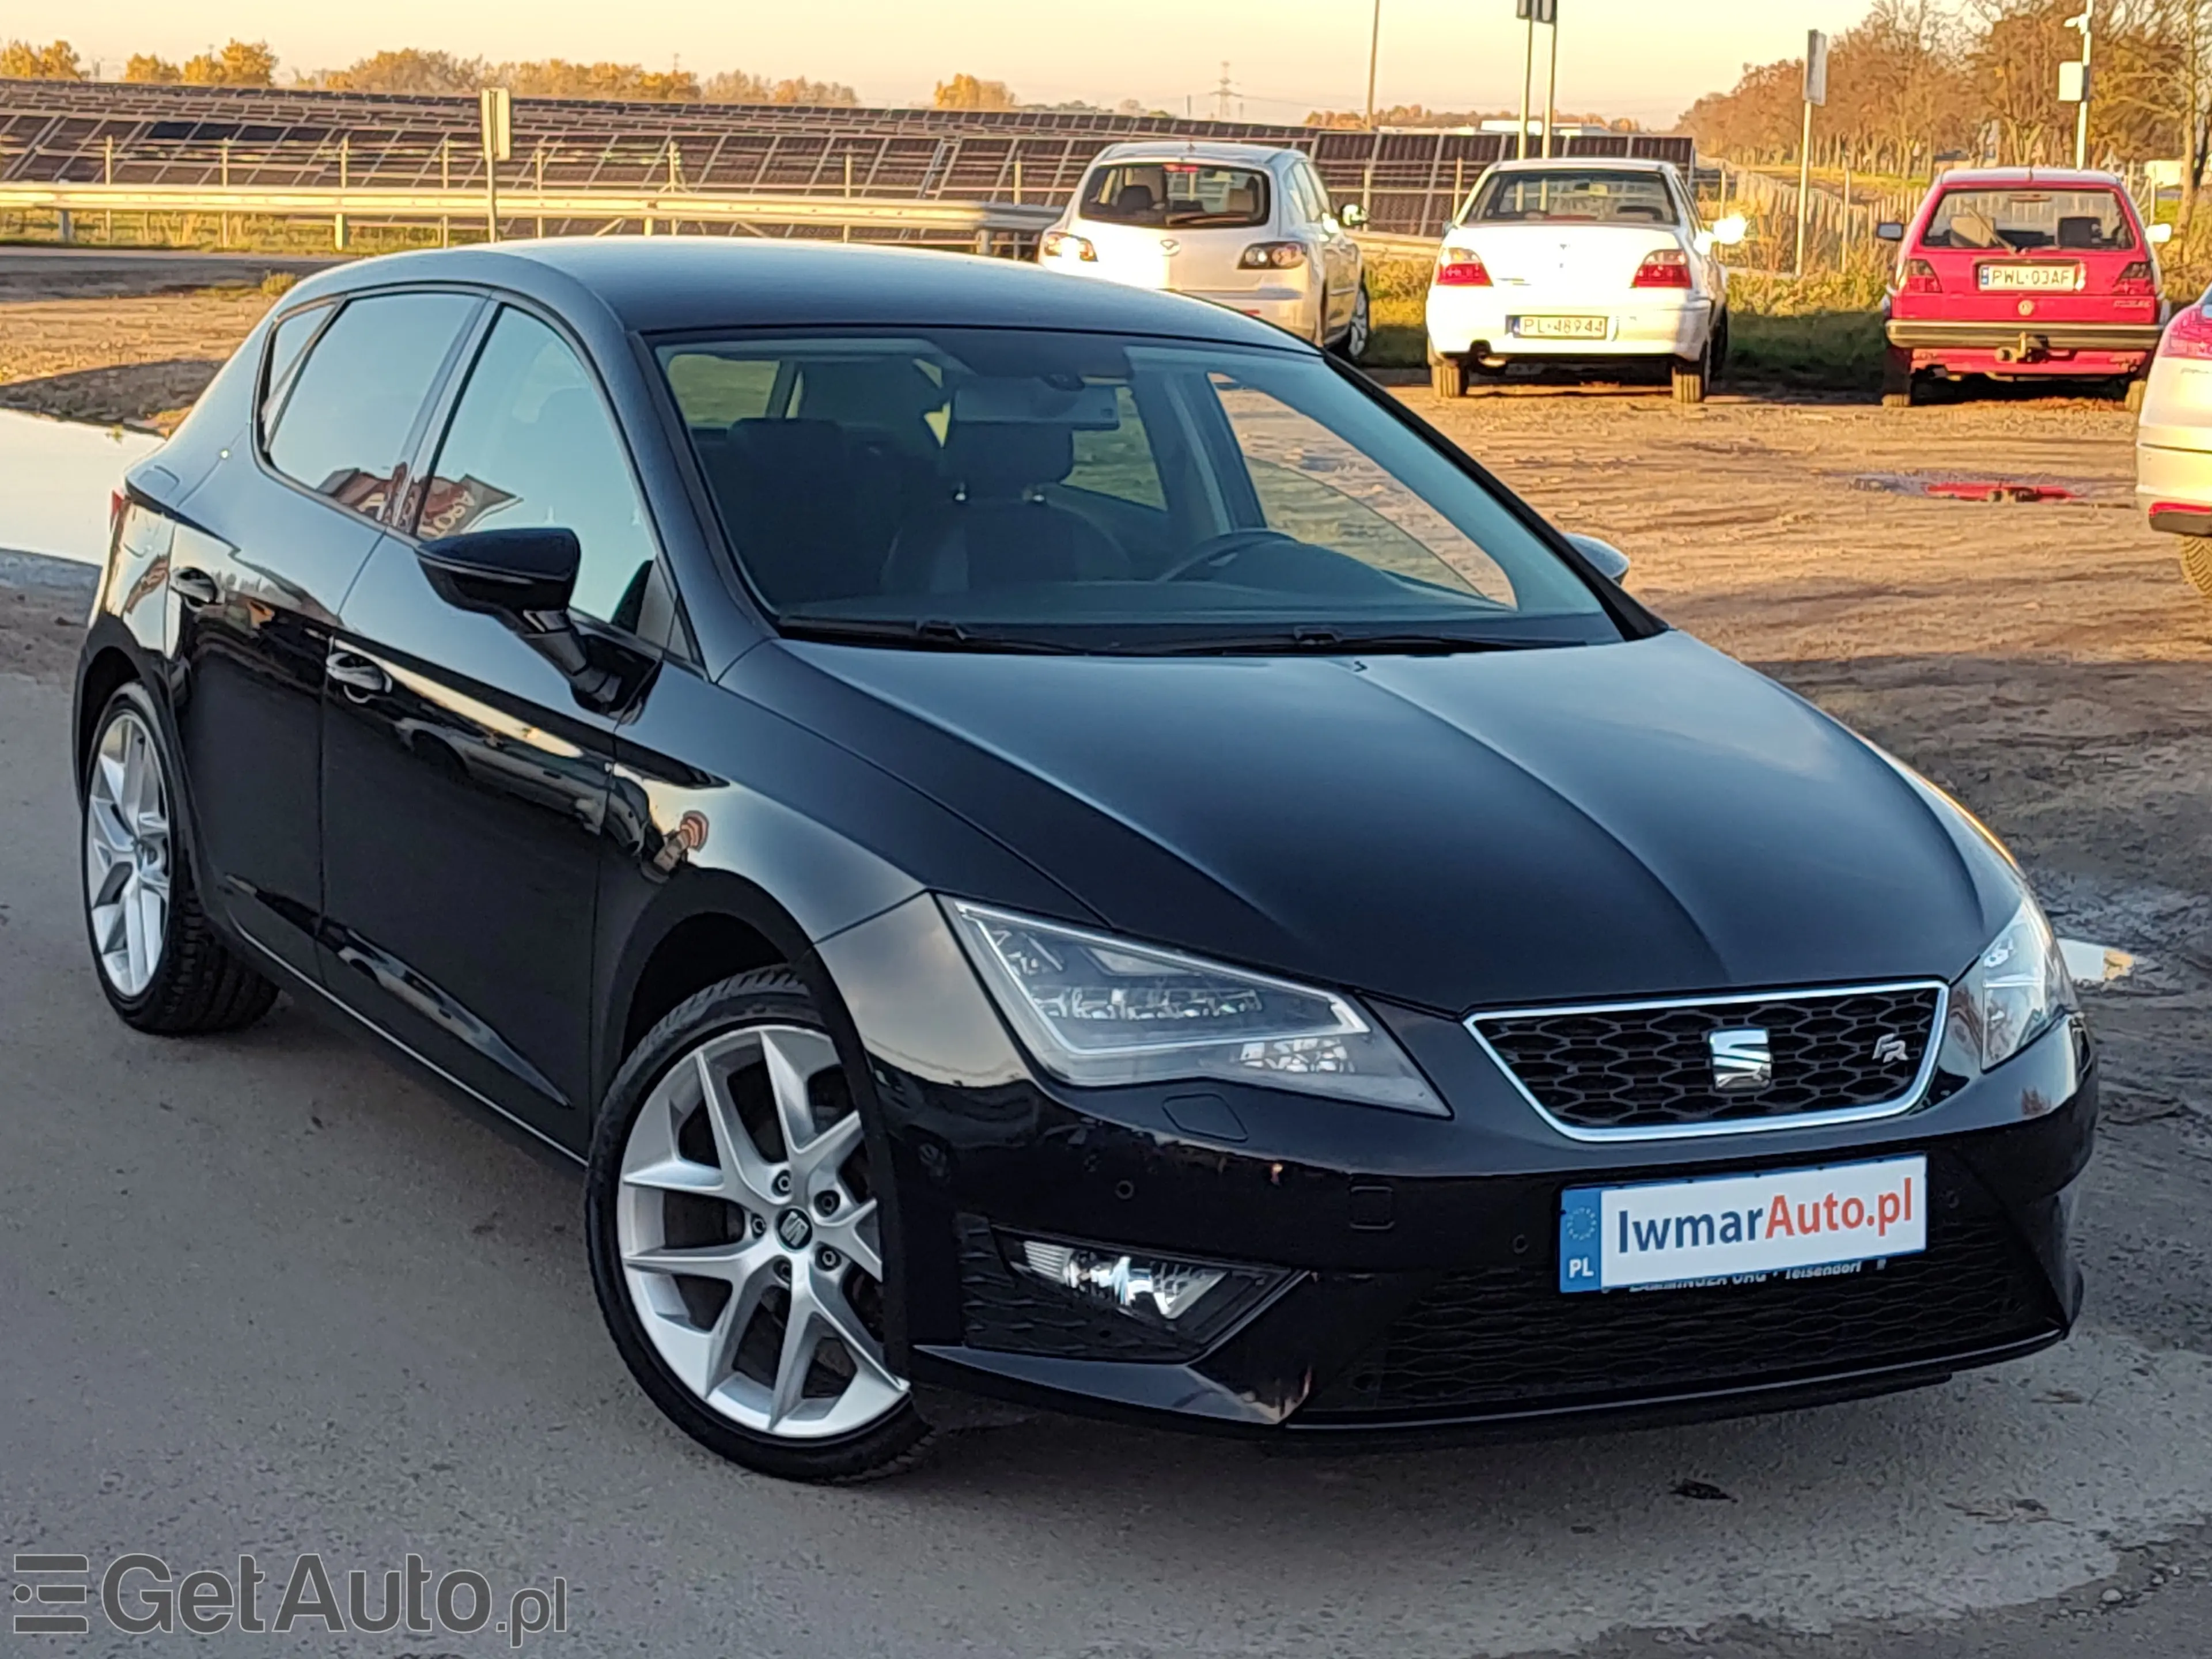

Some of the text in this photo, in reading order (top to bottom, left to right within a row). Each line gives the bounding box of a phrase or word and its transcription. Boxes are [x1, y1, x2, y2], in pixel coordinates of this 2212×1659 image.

[1992, 269, 2070, 285] PWL 03AF
[1524, 319, 1546, 334] PL
[1618, 1177, 1912, 1254] IwmarAuto.pl
[1569, 1256, 1594, 1279] PL
